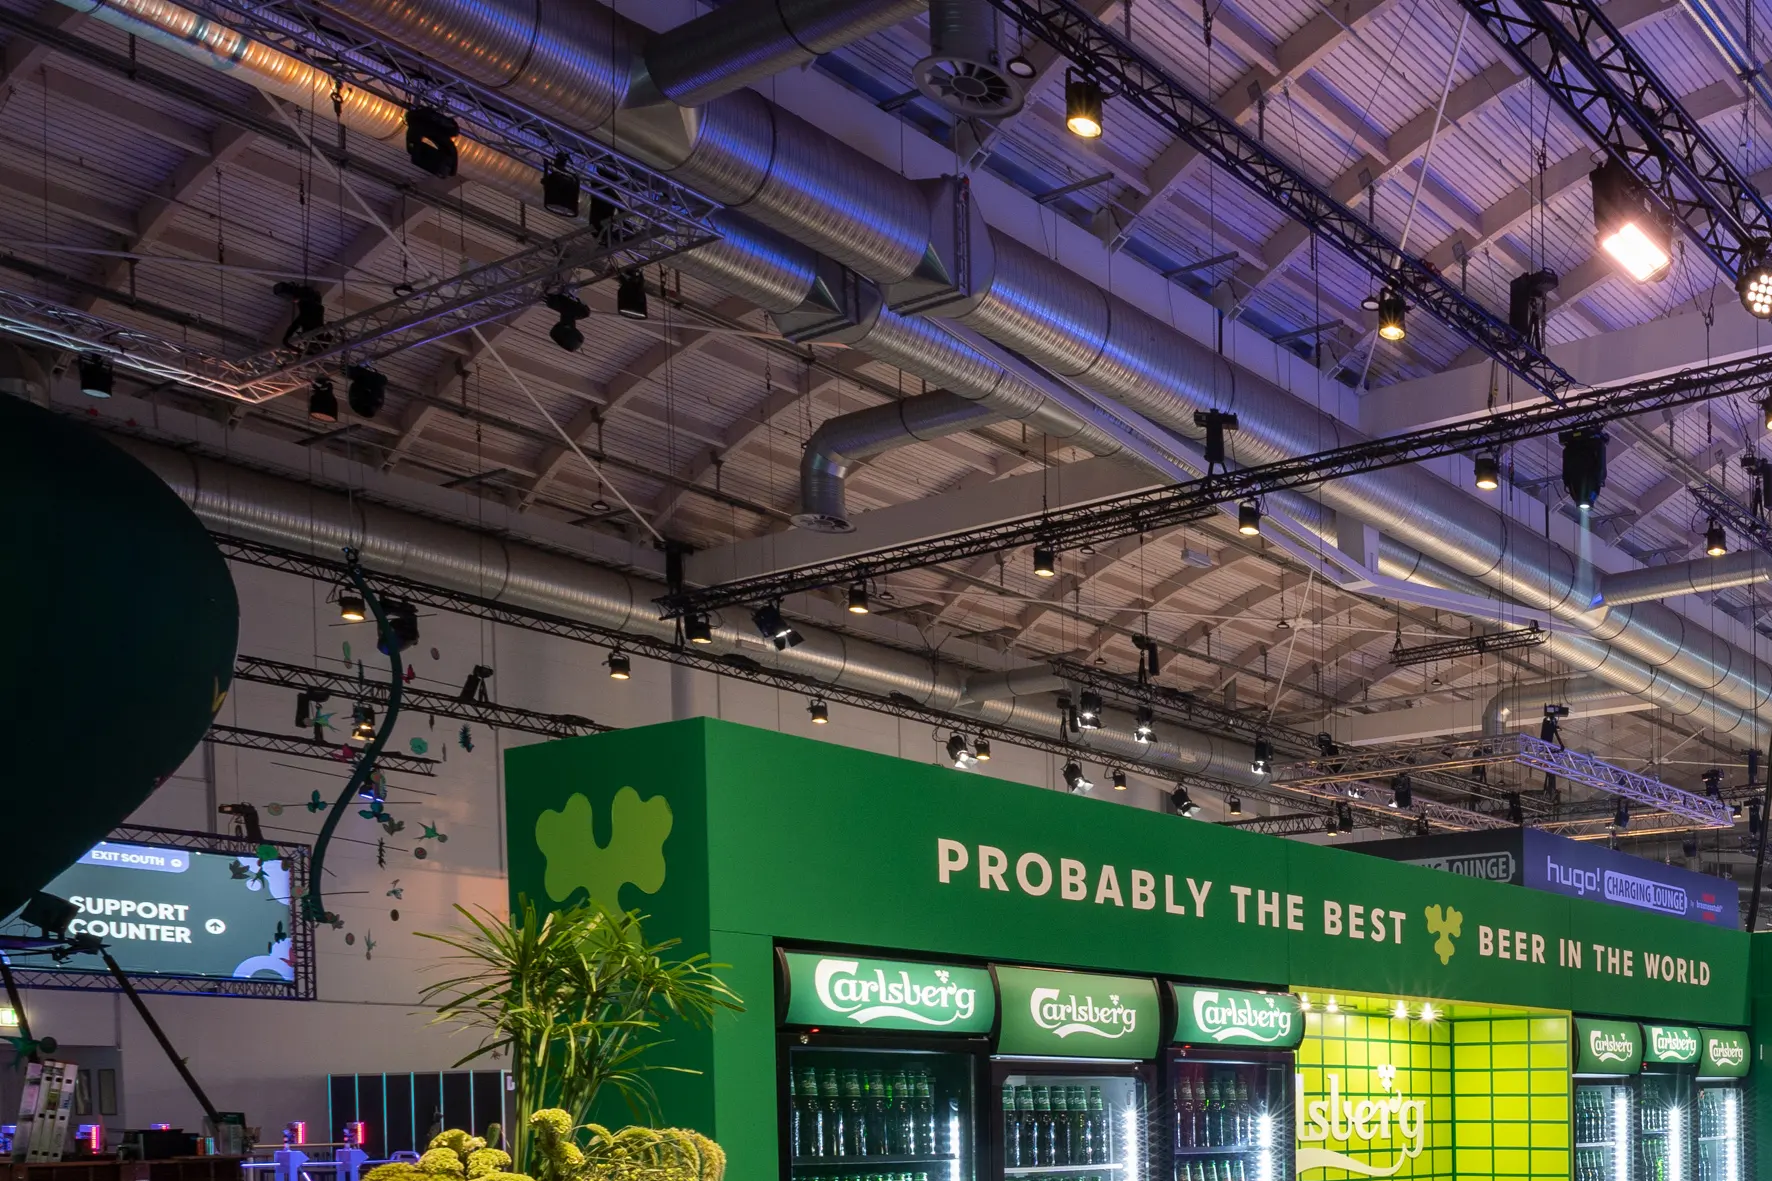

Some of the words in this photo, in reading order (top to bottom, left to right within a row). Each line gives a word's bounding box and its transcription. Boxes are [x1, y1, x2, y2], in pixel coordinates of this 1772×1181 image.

[92, 851, 120, 861] EXIT
[121, 854, 164, 866] SOUTH
[1547, 855, 1600, 895] hugo!
[1607, 876, 1651, 903] CHARGING
[1652, 885, 1684, 911] LOUNGE
[69, 896, 189, 921] SUPPORT
[937, 837, 1212, 918] PROBABLY
[1230, 885, 1304, 931] THE
[1324, 900, 1406, 944] BEST
[1478, 925, 1546, 964] BEER
[1559, 938, 1581, 969] IN
[1593, 943, 1633, 978] THE
[1643, 952, 1711, 986] WORLD
[68, 918, 192, 943] COUNTER
[814, 958, 976, 1020] Carlsberg
[1030, 988, 1137, 1035] Carlsberg
[1193, 990, 1292, 1038] Carlsberg
[1590, 1030, 1633, 1059] Carlsberg
[1652, 1027, 1697, 1057] Carlsberg
[1709, 1039, 1744, 1063] Carlsberg
